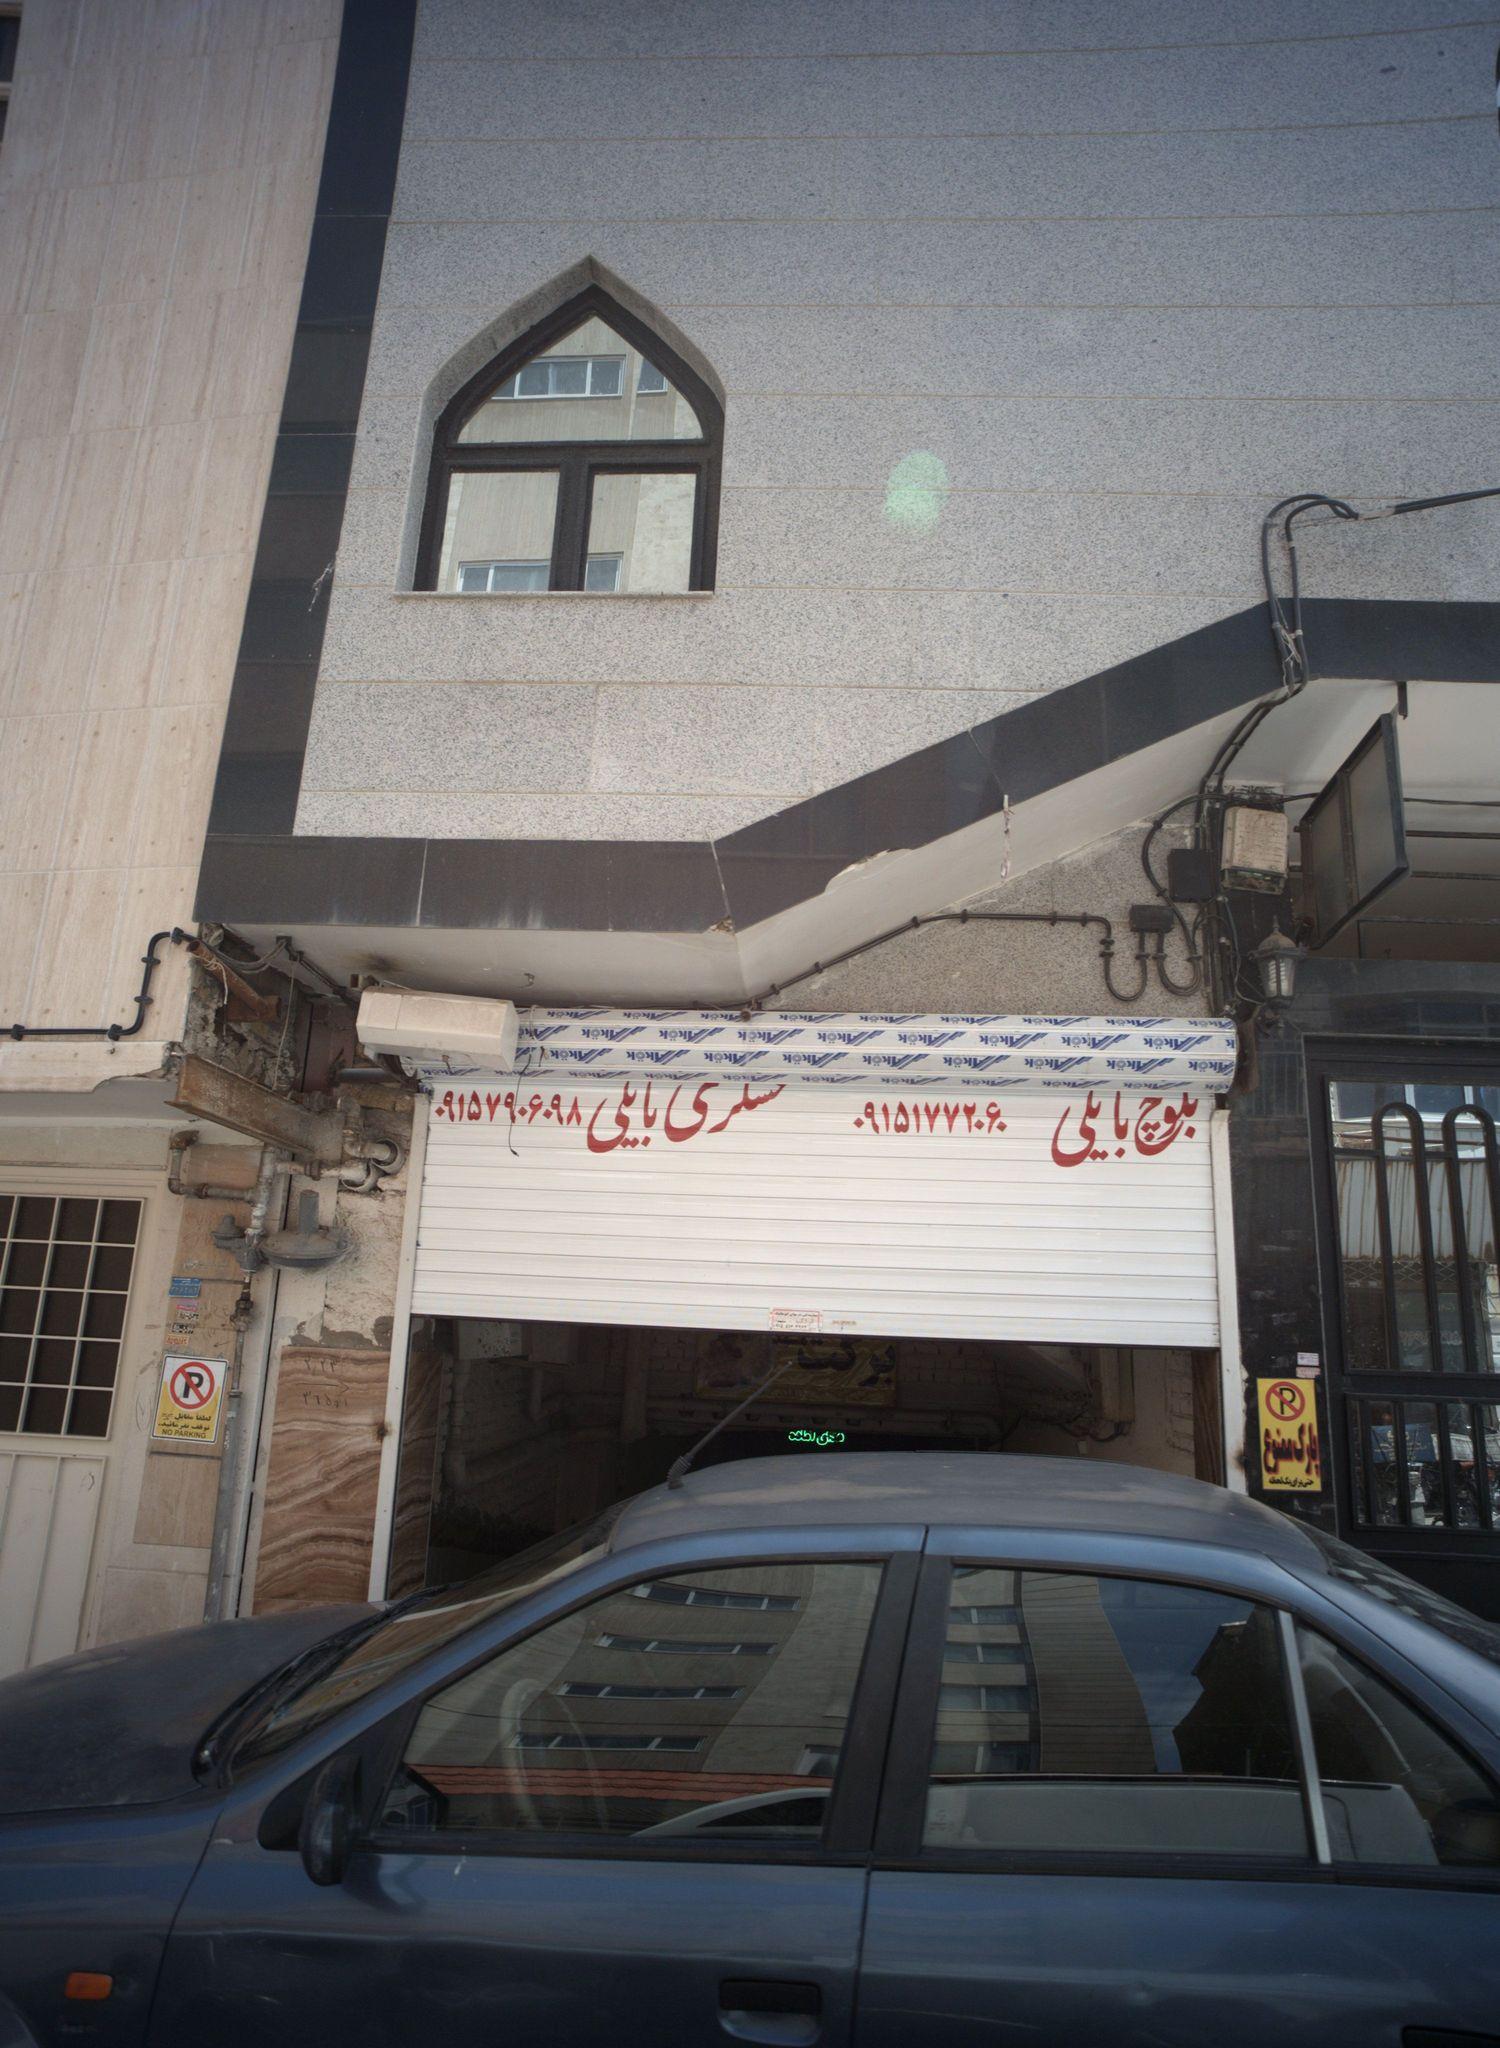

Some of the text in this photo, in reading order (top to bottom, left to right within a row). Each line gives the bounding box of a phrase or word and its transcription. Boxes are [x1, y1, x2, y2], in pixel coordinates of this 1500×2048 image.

[434, 1090, 583, 1126] ۰۹۱۵۷۹۰۶۰۹۸
[853, 1101, 1008, 1135] ۰۹۱۵۱۷۷۲۰۶۰
[1134, 1092, 1199, 1157] بلوچ
[161, 1428, 207, 1439] NO PARKING
[1263, 1427, 1295, 1475] ممنوع
[1294, 1422, 1320, 1478] پارک
